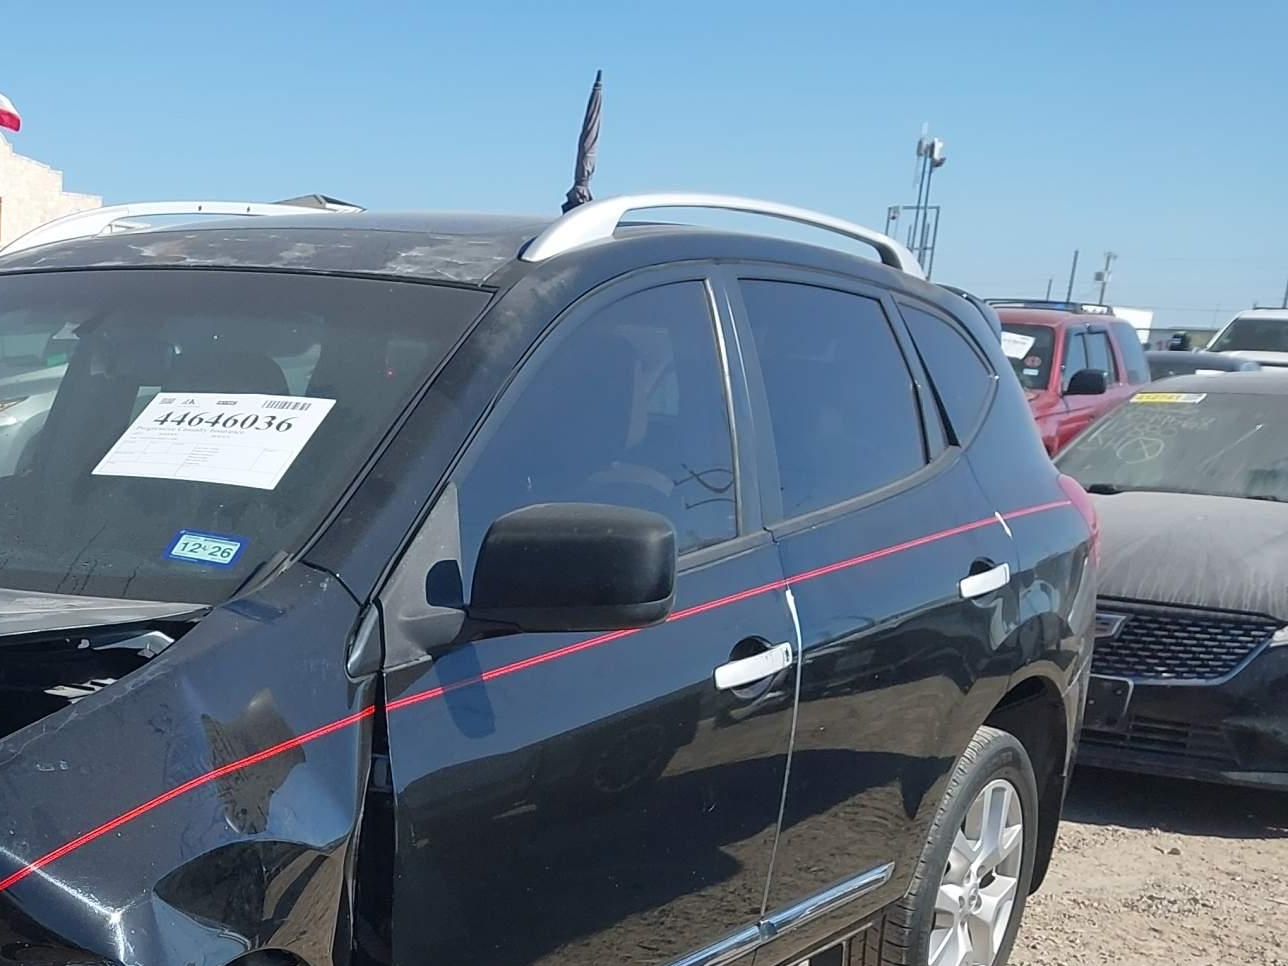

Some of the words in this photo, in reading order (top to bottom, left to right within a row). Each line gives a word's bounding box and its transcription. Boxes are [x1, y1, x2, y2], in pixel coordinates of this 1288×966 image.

[153, 410, 297, 433] 44646036
[180, 541, 202, 553] 12
[208, 545, 233, 558] 26
